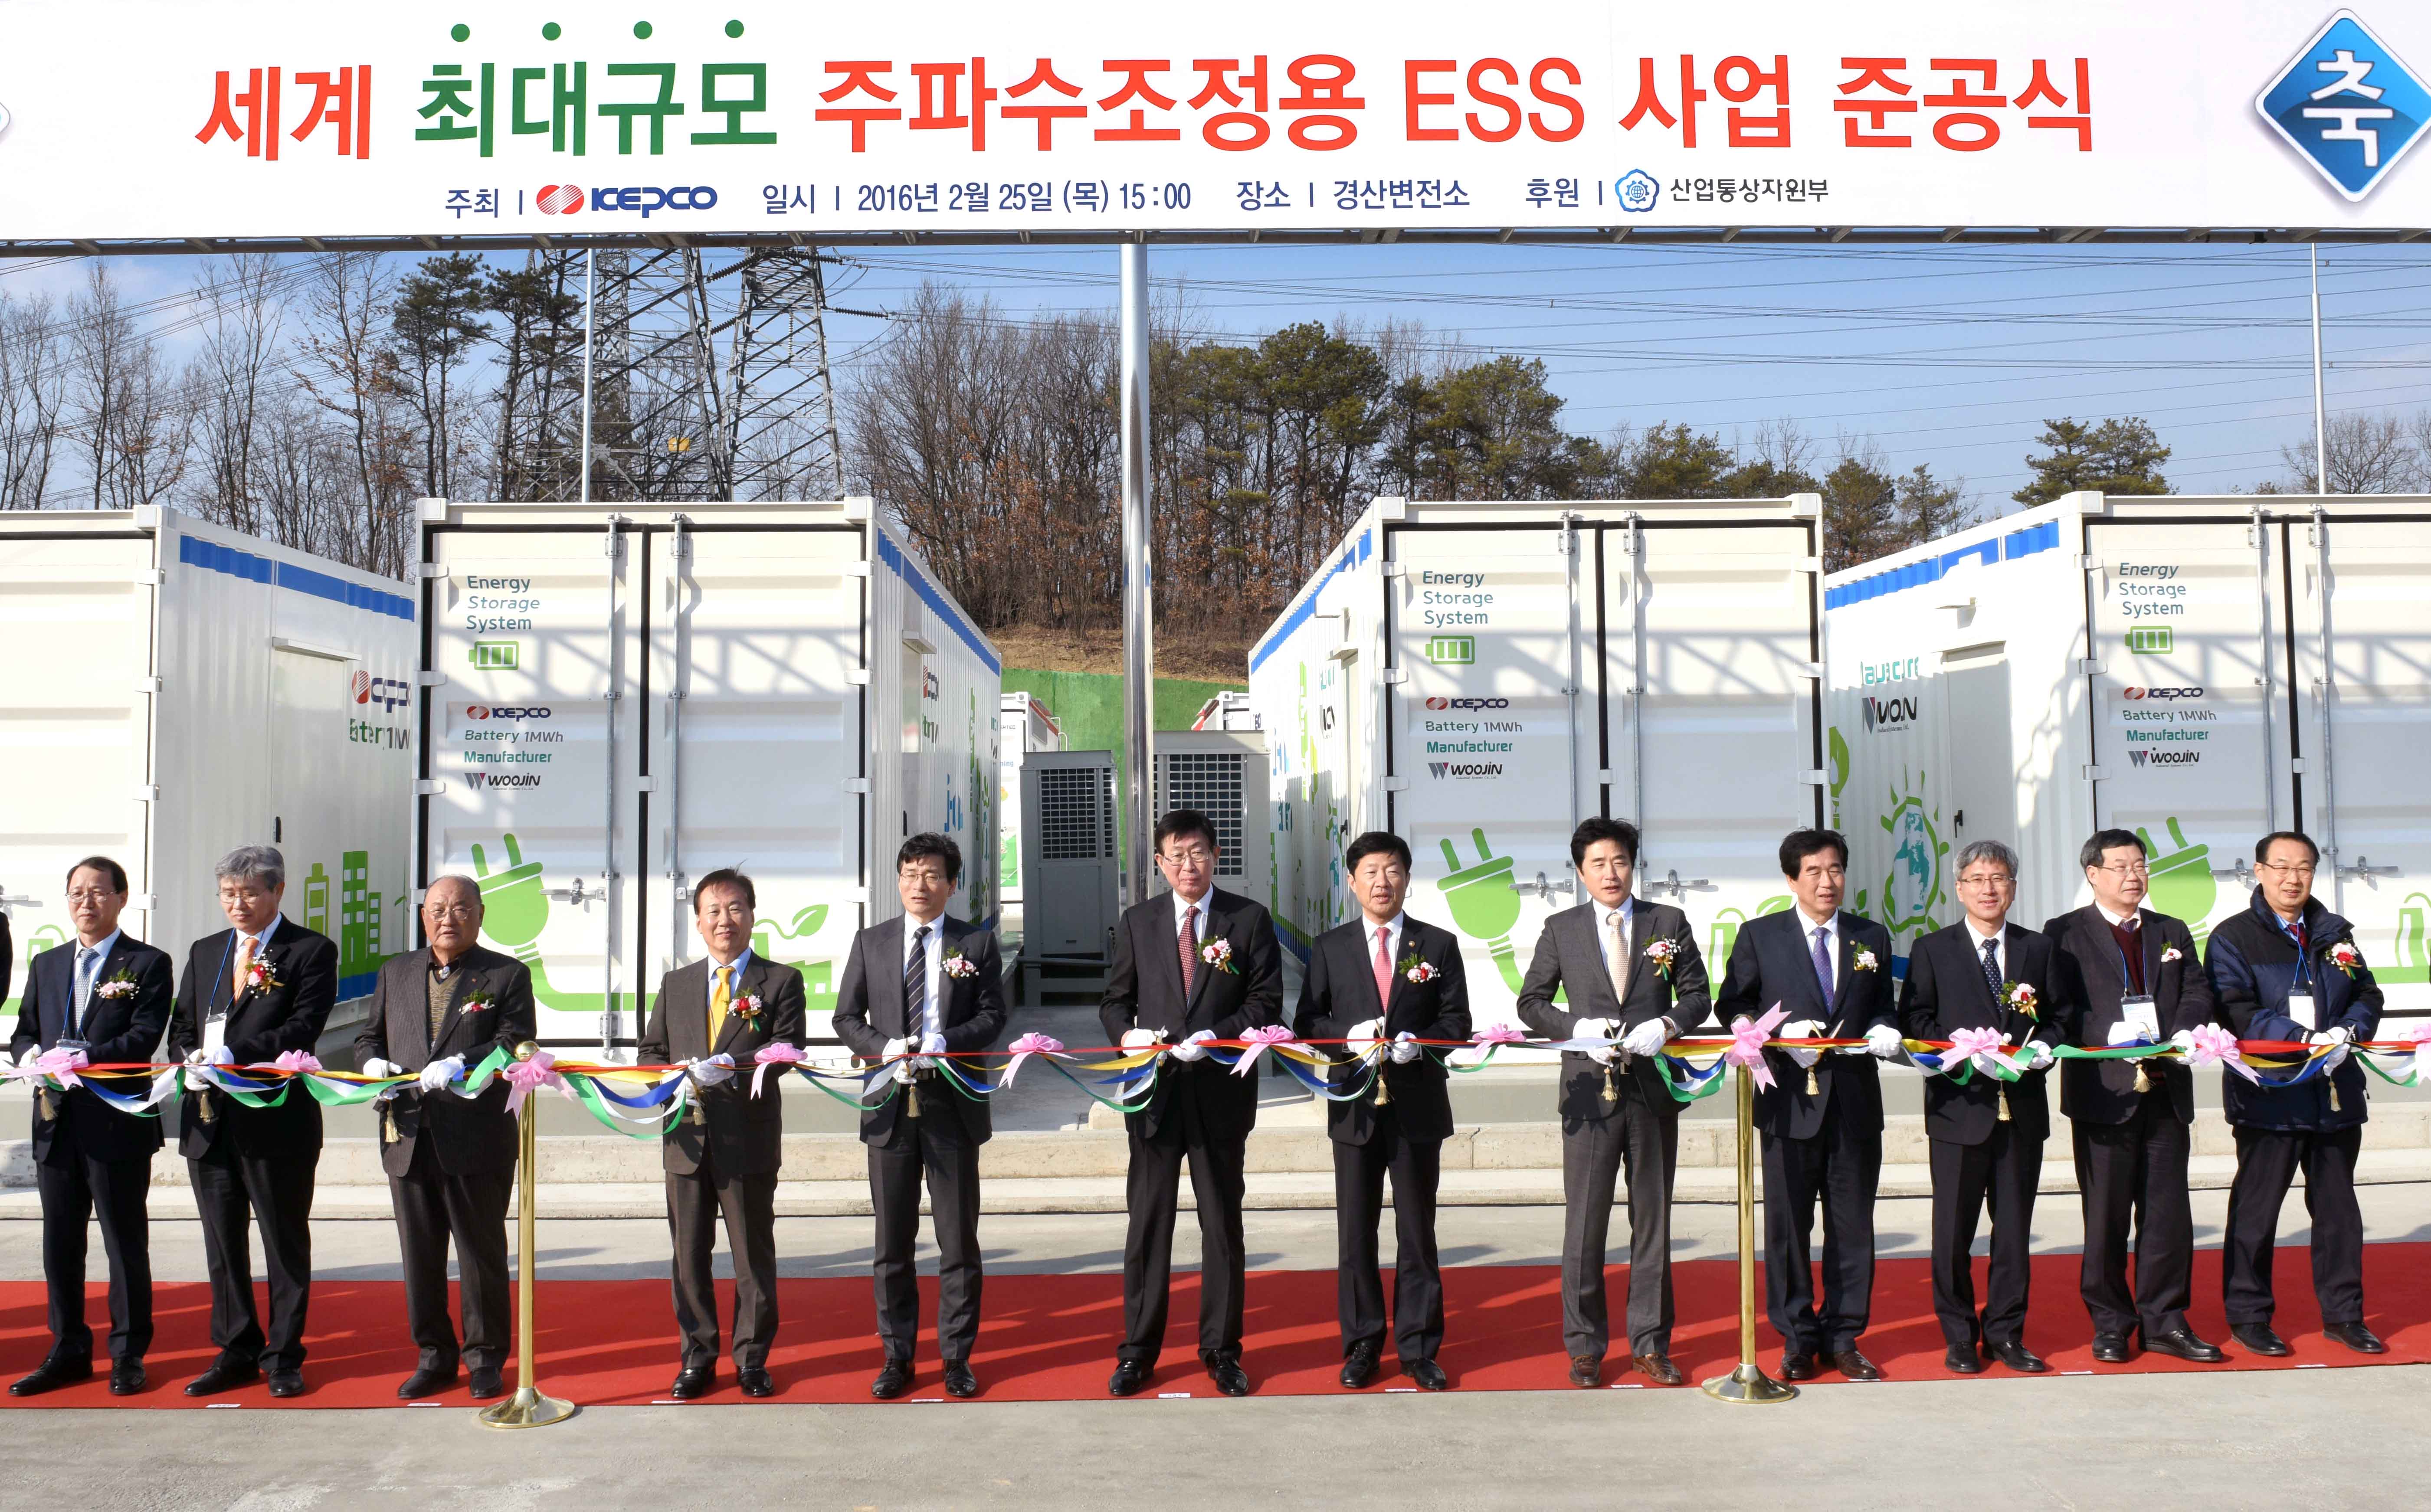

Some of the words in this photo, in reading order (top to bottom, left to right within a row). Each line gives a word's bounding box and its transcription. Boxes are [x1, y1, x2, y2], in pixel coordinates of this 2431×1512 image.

[195, 65, 371, 160] 세계
[416, 62, 776, 157] 최대규모
[816, 54, 1365, 152] 주파수조정용
[1405, 58, 1584, 142] ESS
[1618, 55, 1791, 148] 사업
[1834, 57, 2092, 151] 준공식
[2303, 49, 2394, 167] 축
[763, 184, 814, 214] 일시
[858, 183, 937, 212] 2016년
[949, 183, 988, 212] 2월
[999, 182, 1052, 211] 25일
[1064, 180, 1108, 213] (목)
[1237, 181, 1290, 210] 장소
[1334, 180, 1469, 209] 경산변전소
[1526, 179, 1578, 208] 후원
[1671, 179, 1828, 203] 산업통상자원부
[446, 189, 498, 218] 주최
[1423, 571, 1484, 588] Energy
[2119, 563, 2179, 579] Energy
[467, 576, 530, 593] Energy
[2119, 583, 2186, 598] Storage
[468, 596, 540, 612] Storage
[1424, 591, 1493, 607] Storage
[2123, 601, 2183, 619] System
[466, 615, 531, 634] System
[1424, 610, 1487, 628] System
[2123, 710, 2174, 722] Battery
[2178, 710, 2217, 721] 1MWh
[1425, 721, 1478, 733] Battery
[1484, 722, 1522, 732] 1MWh
[2126, 729, 2209, 741] Manufacturer
[465, 730, 520, 743] Battery
[524, 731, 563, 742] 1MWh
[1427, 740, 1513, 753] Manufacturer
[464, 750, 552, 763] Manufacturer
